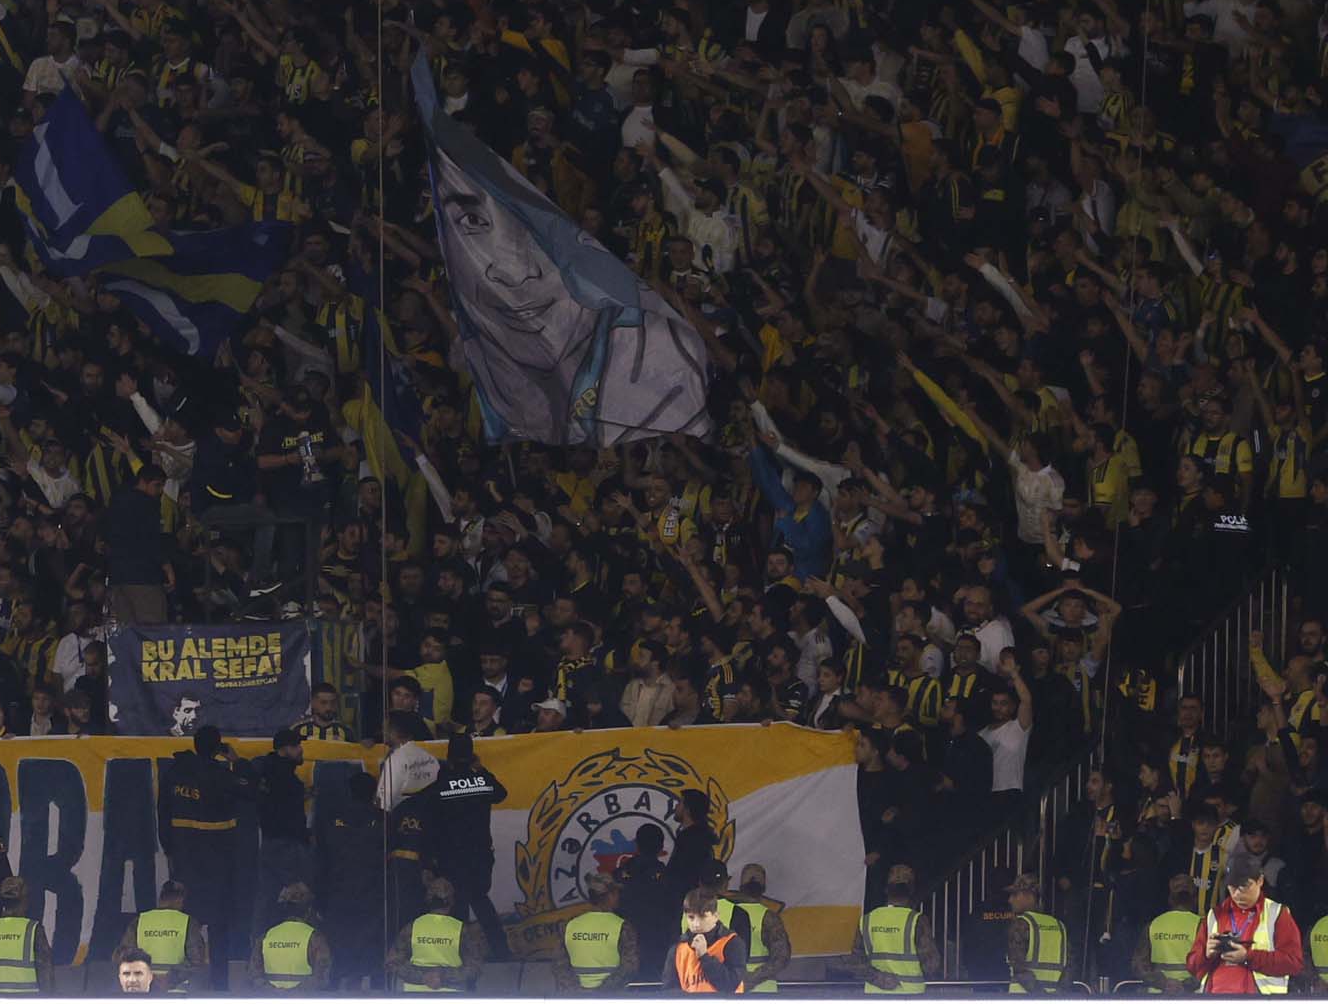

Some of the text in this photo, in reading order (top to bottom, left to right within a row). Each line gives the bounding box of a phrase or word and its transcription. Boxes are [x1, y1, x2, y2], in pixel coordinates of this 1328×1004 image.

[142, 632, 282, 661] BU ALEMDE
[142, 653, 282, 682] KRAL SEFA!
[870, 925, 900, 934] SECURITY
[144, 931, 179, 939] SECURITY
[572, 932, 609, 941] SECURITY
[1154, 932, 1190, 941] SECURITY
[268, 941, 301, 949] SECURITY
[417, 936, 453, 945] SECURITY
